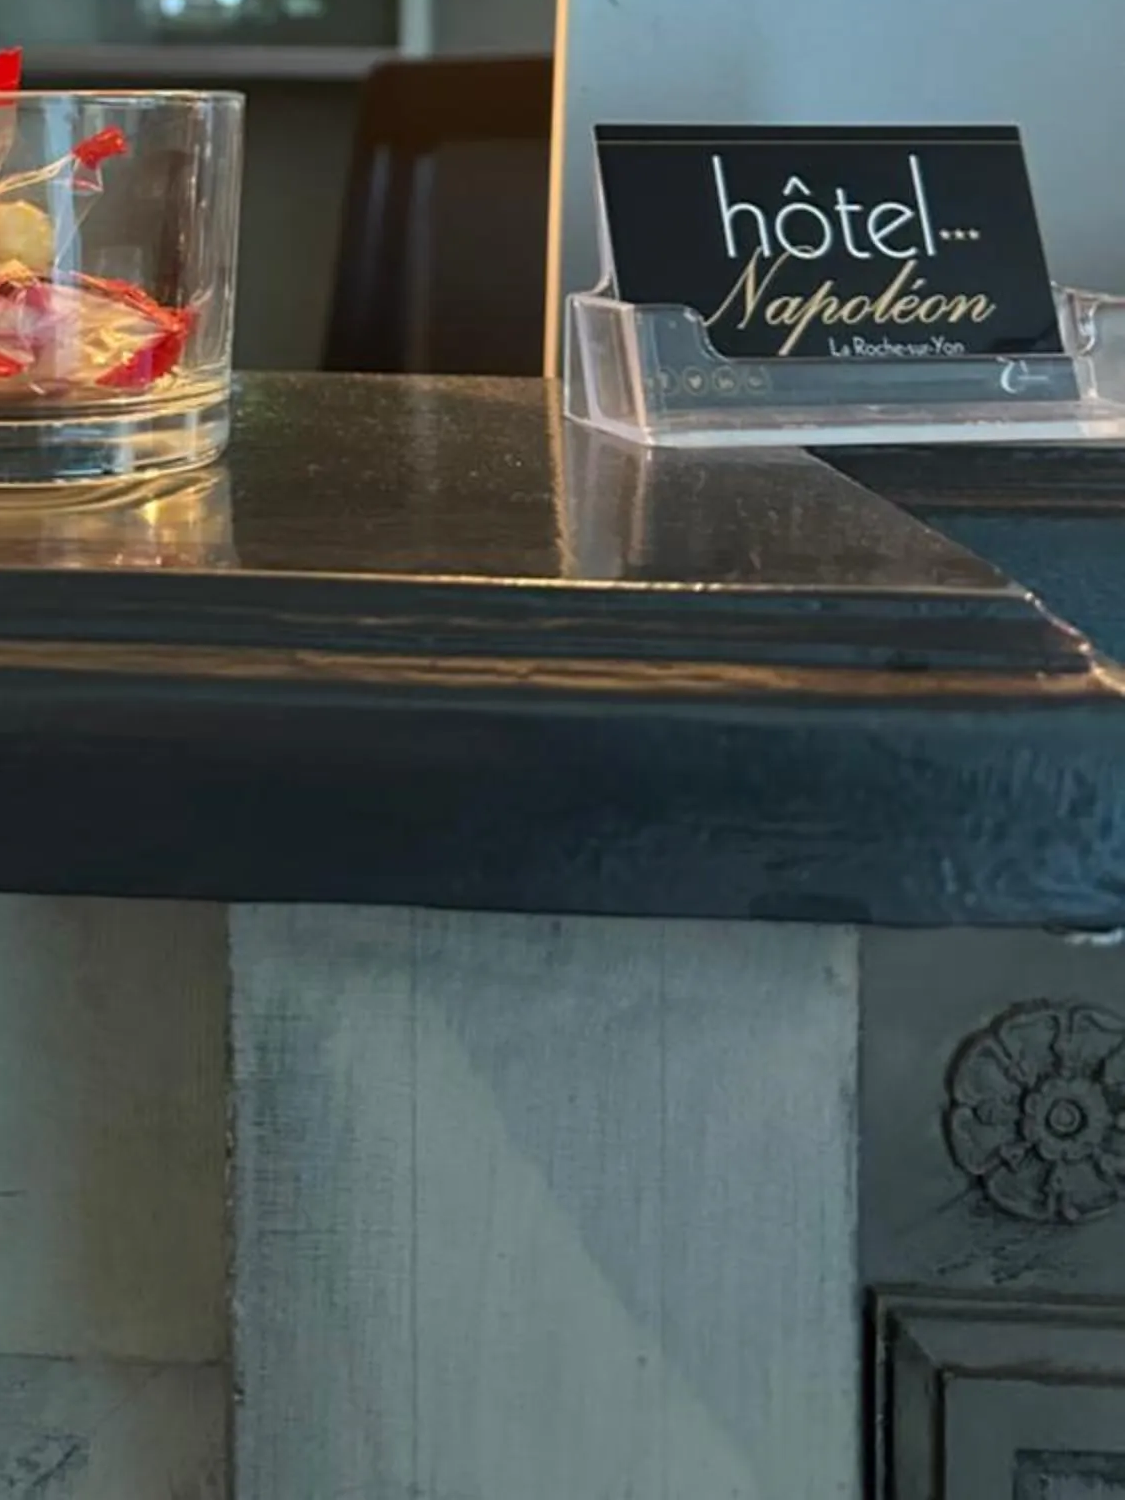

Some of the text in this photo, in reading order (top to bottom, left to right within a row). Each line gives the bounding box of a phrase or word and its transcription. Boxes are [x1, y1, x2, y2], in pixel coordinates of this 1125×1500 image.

[712, 154, 936, 258] hôtel
[703, 245, 997, 357] Napoléon
[828, 336, 851, 357] La
